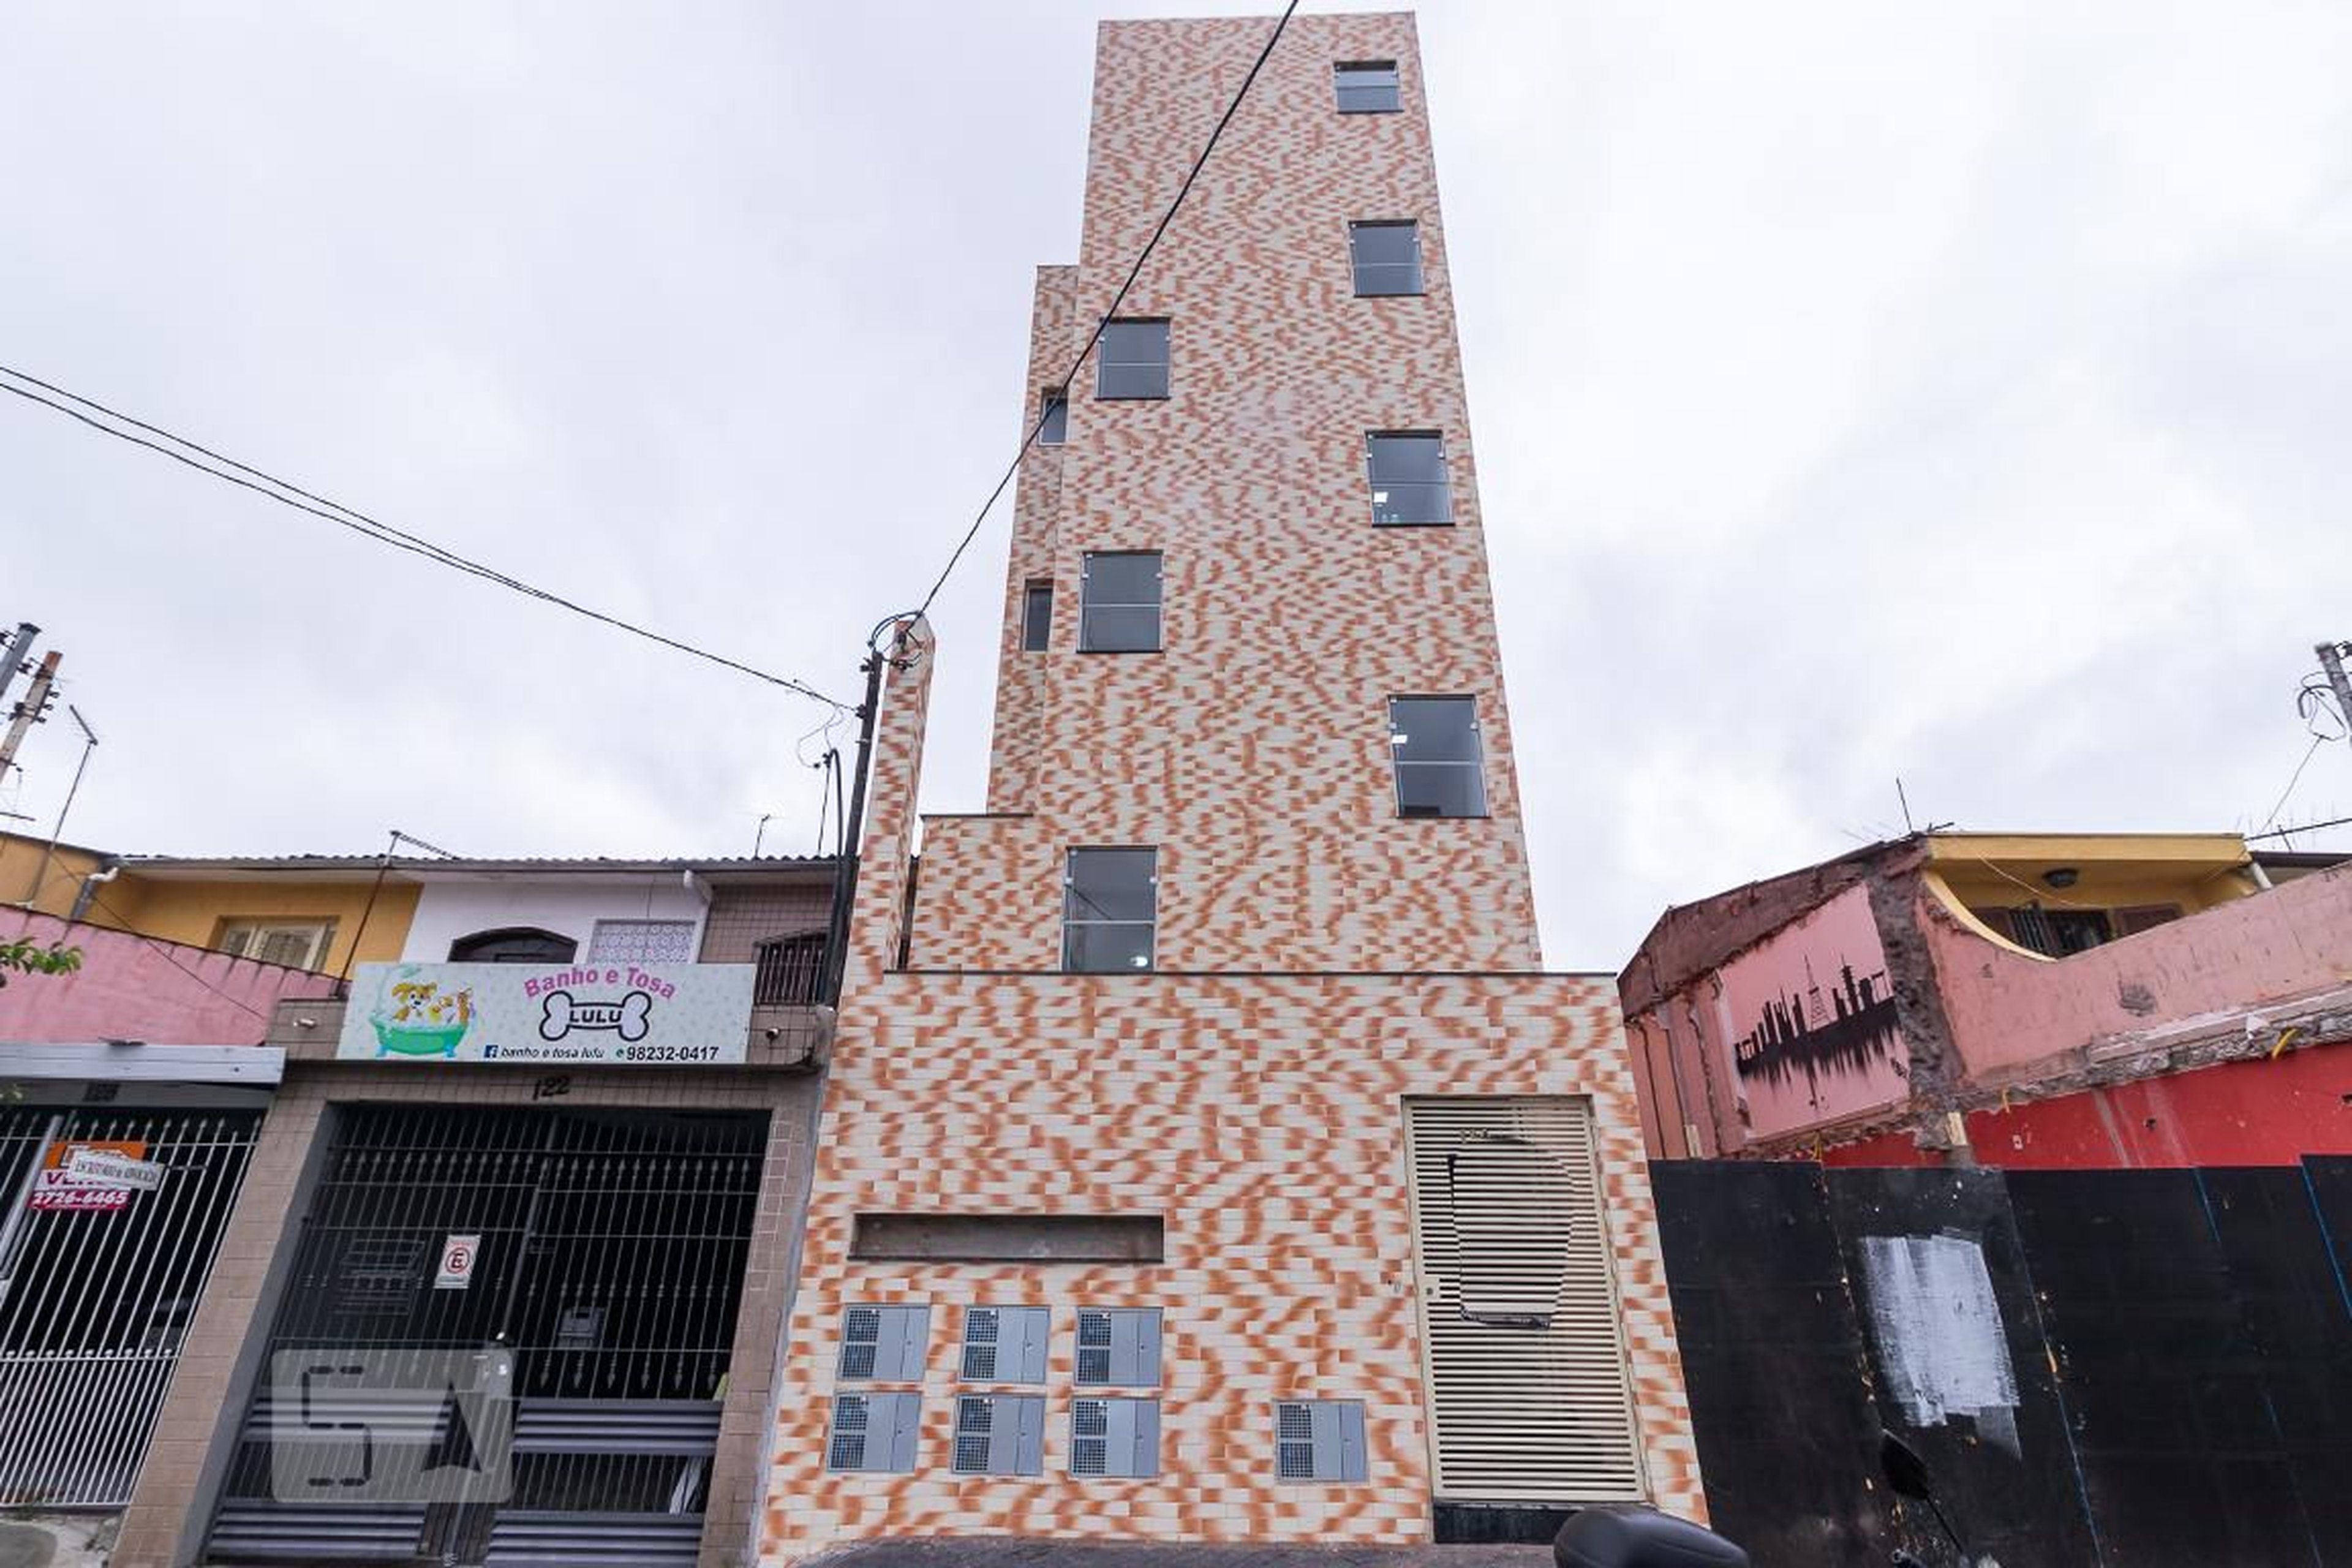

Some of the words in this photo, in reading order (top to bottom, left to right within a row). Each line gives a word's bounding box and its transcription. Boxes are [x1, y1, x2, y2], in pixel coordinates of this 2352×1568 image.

[525, 967, 599, 998] Banho
[606, 968, 619, 984] e
[627, 967, 676, 1000] Tosa
[569, 1010, 622, 1023] LULU
[501, 1047, 540, 1058] banho
[542, 1048, 550, 1058] e
[552, 1047, 579, 1058] tosa
[626, 1046, 720, 1061] 98232-0417
